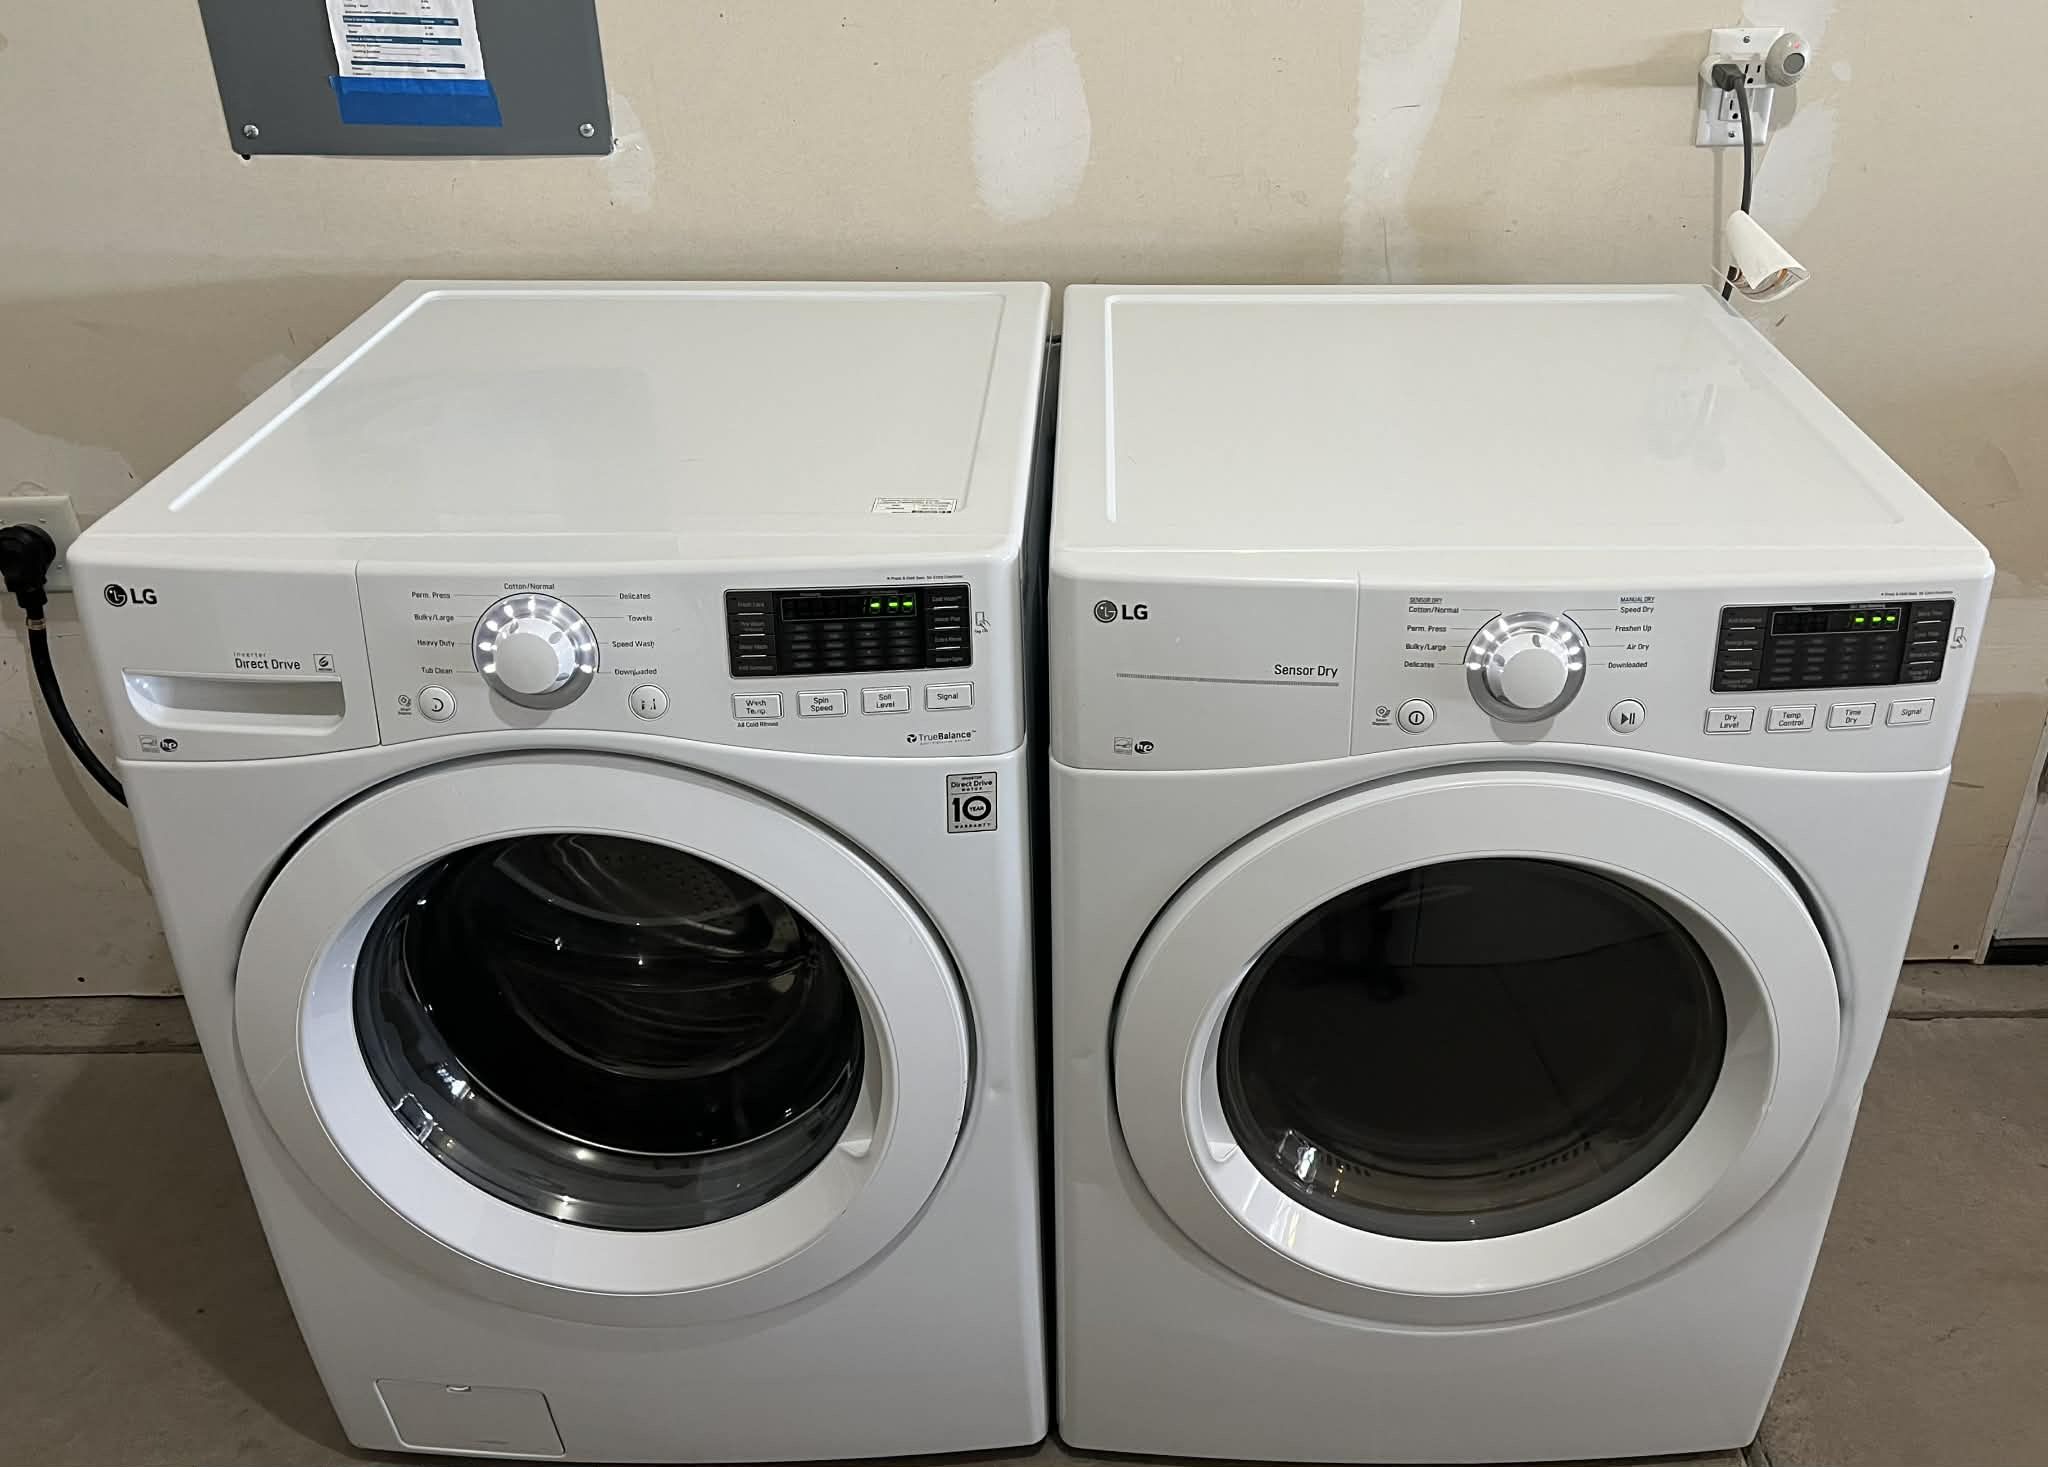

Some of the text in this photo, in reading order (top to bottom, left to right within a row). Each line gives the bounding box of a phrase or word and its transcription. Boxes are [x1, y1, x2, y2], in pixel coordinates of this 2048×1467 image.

[130, 588, 157, 605] LG
[619, 592, 651, 600] Delicates
[1122, 604, 1148, 620] LG
[1621, 606, 1654, 614] Speed Dry
[414, 614, 454, 622] Bulky/Large
[1642, 625, 1652, 633] Up
[417, 640, 455, 648] Heavy Duty
[612, 640, 654, 648] Speed Wash
[1405, 643, 1447, 652] Bulky/Large
[1637, 643, 1649, 651] Dry
[235, 659, 301, 670] Direct Drive
[434, 667, 453, 675] Clean
[1274, 664, 1338, 679] Sensor Dry
[937, 692, 959, 701] Signal
[813, 697, 829, 705] Spin
[876, 701, 895, 709] Level
[810, 704, 833, 712] Speed
[1901, 708, 1922, 716] Signal
[1724, 714, 1738, 722] Dry
[1783, 712, 1801, 720] Temp
[1845, 716, 1857, 724] Dry
[1720, 721, 1739, 729] Level
[1778, 719, 1804, 727] Control
[952, 796, 992, 822] 10
